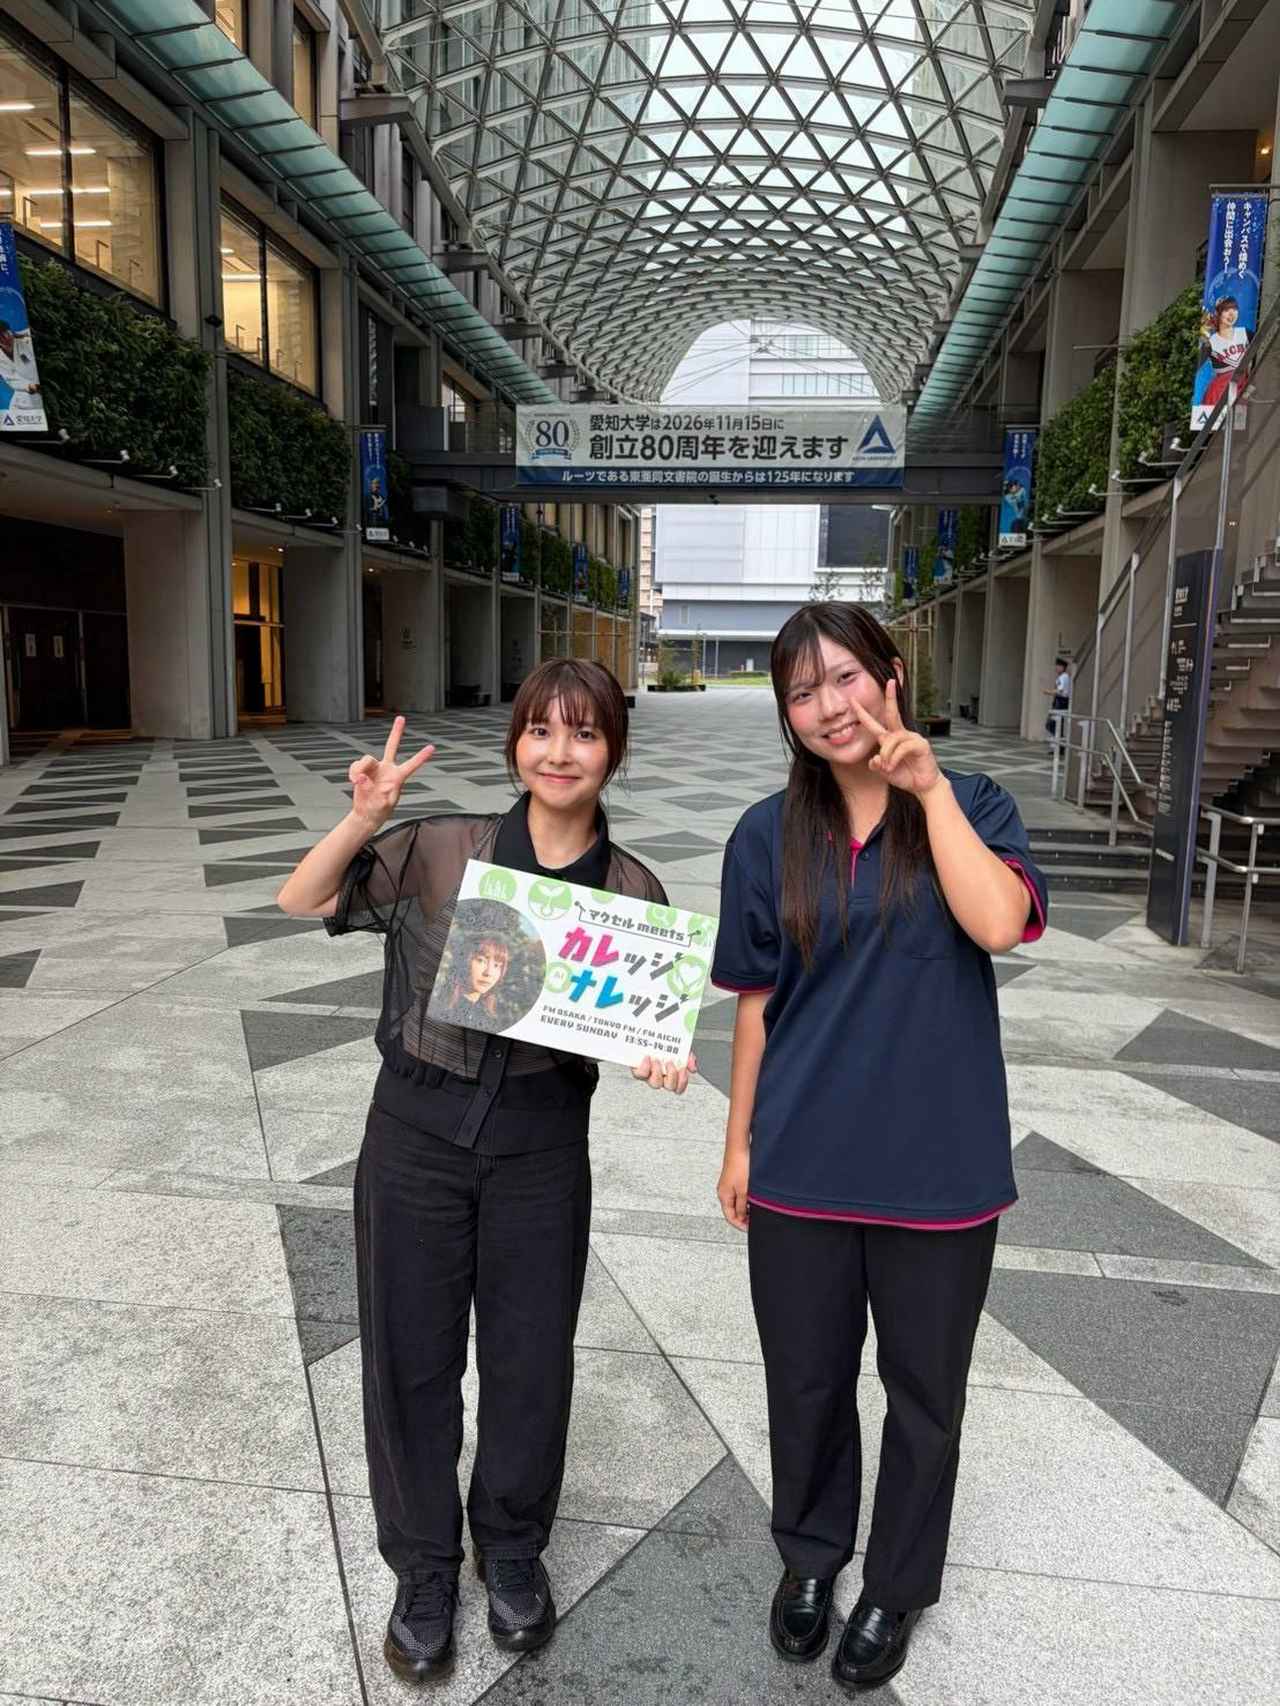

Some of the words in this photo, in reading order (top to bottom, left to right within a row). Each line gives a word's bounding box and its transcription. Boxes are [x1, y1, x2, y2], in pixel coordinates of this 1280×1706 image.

[535, 420, 569, 447] 80
[590, 414, 784, 431] 愛知大学は2026年11月15日に
[589, 434, 849, 461] 創立80周年を迎えます
[589, 909, 635, 929] マクセル
[637, 923, 685, 942] meets
[558, 927, 684, 980] カレッジ
[569, 970, 688, 1022] ナレッジ
[540, 1015, 574, 1028] EVERY
[576, 1023, 618, 1039] SUNDAY
[625, 1035, 679, 1054] 13:55-14:00
[543, 1005, 556, 1014] FM
[557, 1008, 586, 1021] OSAKA
[593, 1016, 621, 1029] TOKYO
[623, 1025, 636, 1033] FM
[643, 1029, 655, 1038] FM
[657, 1033, 681, 1044] AICHI
